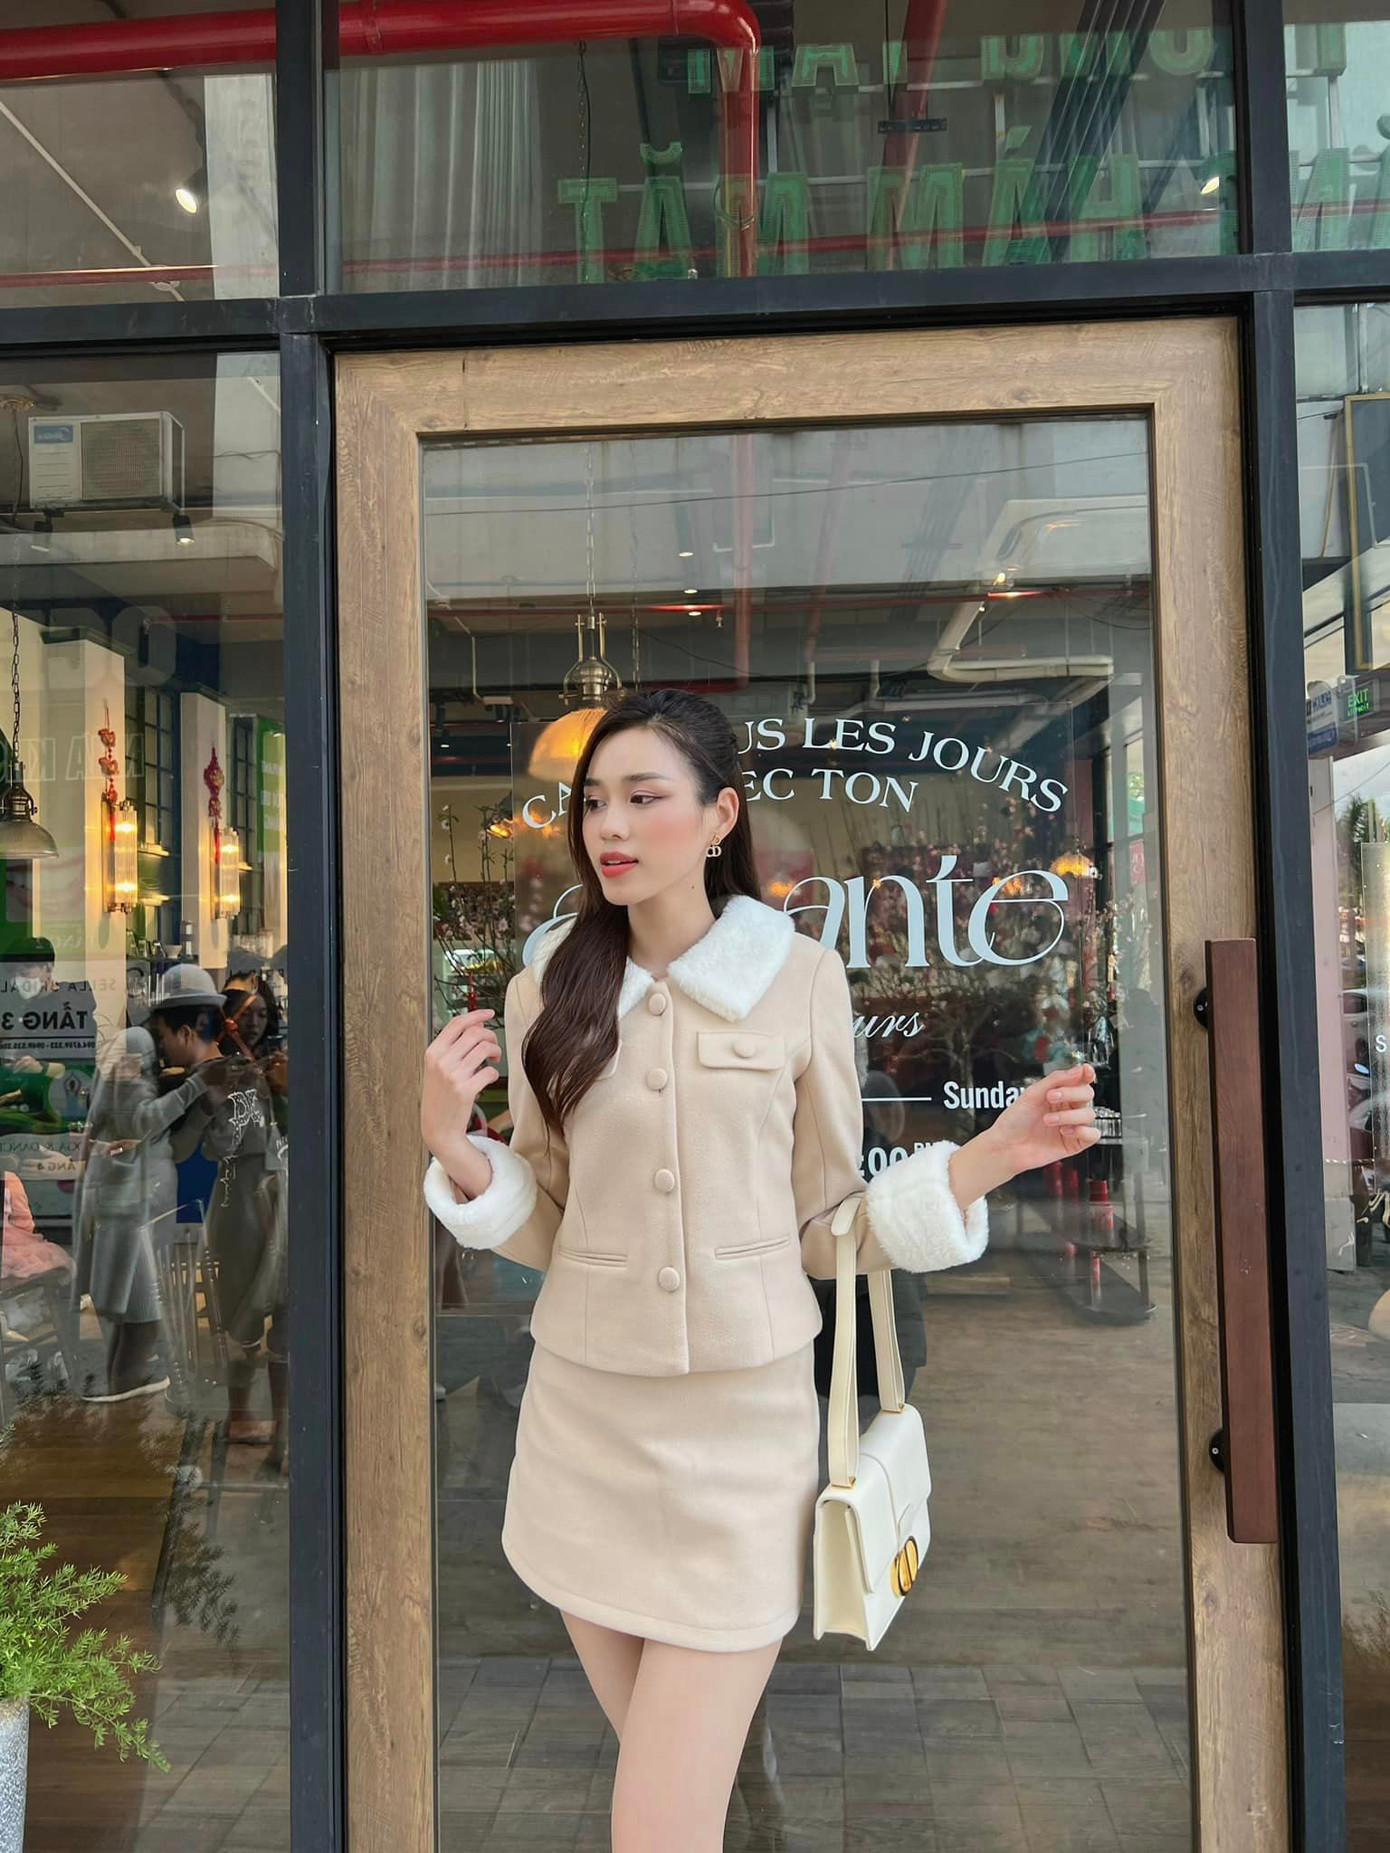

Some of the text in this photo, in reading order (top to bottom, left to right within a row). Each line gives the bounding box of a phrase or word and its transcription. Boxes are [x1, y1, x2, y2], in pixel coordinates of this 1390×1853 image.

[1347, 689, 1369, 708] EXIT
[737, 718, 1069, 813] US LES JOURS
[743, 768, 795, 802] EC
[811, 768, 919, 813] TON
[943, 1080, 1027, 1109] Sunda
